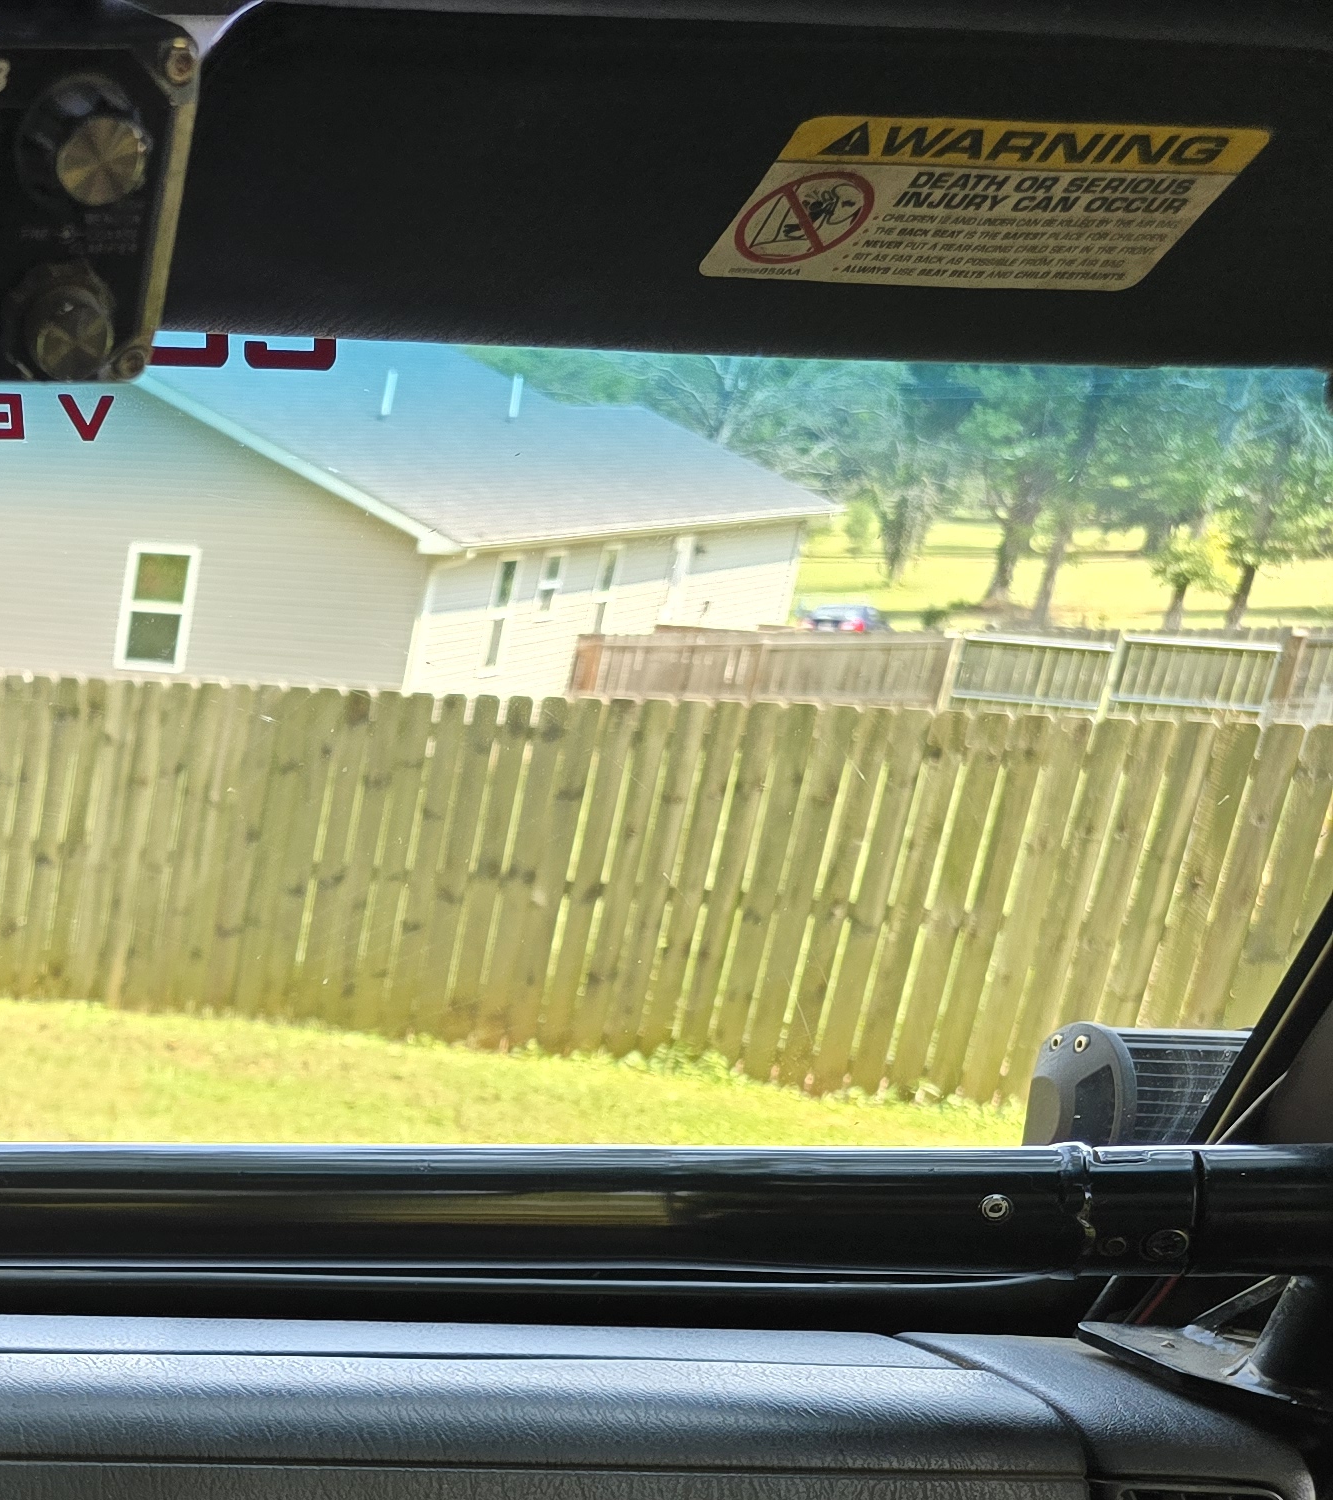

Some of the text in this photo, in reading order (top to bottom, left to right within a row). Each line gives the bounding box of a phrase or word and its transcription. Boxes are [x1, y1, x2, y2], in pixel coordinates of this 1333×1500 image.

[881, 124, 1232, 166] WARNING
[907, 171, 1195, 196] DEATH OR SERIOUS
[893, 191, 1190, 215] INJURY CAN OCCUR
[897, 228, 929, 238] BACK
[862, 239, 904, 249] NEVER
[904, 241, 930, 251] PUT
[842, 265, 891, 275] ALWAYS
